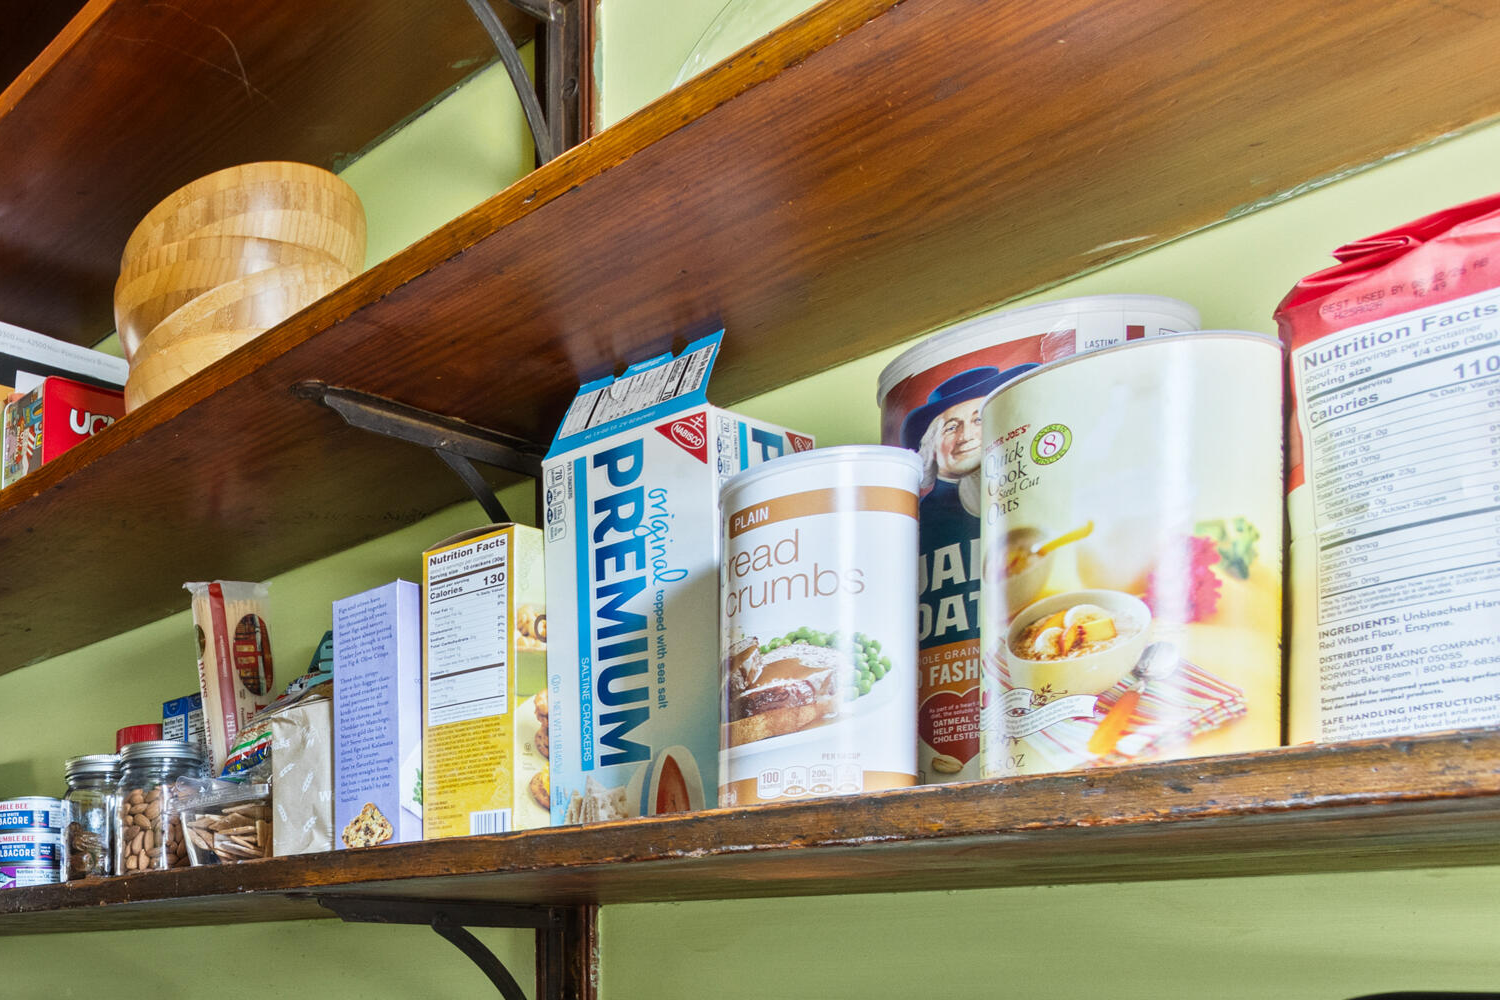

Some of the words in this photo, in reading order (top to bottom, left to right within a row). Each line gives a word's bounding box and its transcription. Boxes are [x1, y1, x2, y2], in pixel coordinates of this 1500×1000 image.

[1356, 289, 1385, 304] USED
[1302, 328, 1411, 370] Nutrition
[1420, 300, 1498, 334] Facts
[1306, 375, 1345, 393] Serving
[1348, 365, 1372, 378] size
[1412, 347, 1430, 359] 1/4
[1434, 339, 1459, 354] cup
[1350, 347, 1397, 367] servings
[1309, 394, 1379, 424] Calories
[1453, 356, 1500, 381] 110
[1357, 377, 1392, 392] serving
[673, 423, 702, 447] NABISCO
[1043, 434, 1058, 455] 8
[985, 441, 1024, 480] Quick
[988, 461, 1028, 497] Cook
[1020, 476, 1040, 491] Cut
[1334, 473, 1395, 494] Carbohydrate
[734, 506, 770, 532] PLAIN
[429, 547, 473, 566] Nutrition
[476, 537, 505, 553] Facts
[429, 585, 463, 600] Calories
[483, 572, 504, 586] 130
[725, 563, 866, 618] crumbs
[592, 437, 653, 768] PREMIUM
[653, 589, 666, 632] topped
[1317, 616, 1399, 639] INGREDIENTS:
[1403, 603, 1471, 623] Unbleached
[1318, 640, 1335, 650] Red
[1337, 633, 1368, 646] Wheat
[1371, 626, 1402, 640] Flour,
[1404, 618, 1453, 635] Enzyme.
[656, 631, 668, 660] with
[944, 646, 980, 660] GRAIN
[1319, 647, 1379, 664] DISTRIBUTED
[1381, 643, 1394, 652] BY
[1319, 662, 1340, 673] KING
[1342, 655, 1383, 668] ARTHUR
[1385, 647, 1428, 661] BAKING
[1429, 636, 1494, 654] COMPANY,
[580, 656, 591, 701] SALTINE
[657, 662, 666, 684] sea
[1319, 668, 1367, 682] NORWICH,
[1369, 658, 1424, 673] VERMONT
[1427, 651, 1462, 663] 05055
[657, 686, 668, 709] salt
[933, 715, 970, 728] OATMEAL
[933, 726, 954, 735] HELP
[1321, 717, 1344, 726] SAFE
[1345, 708, 1404, 722] HANDLING
[581, 703, 593, 762] CRACKERS
[762, 772, 780, 784] 100
